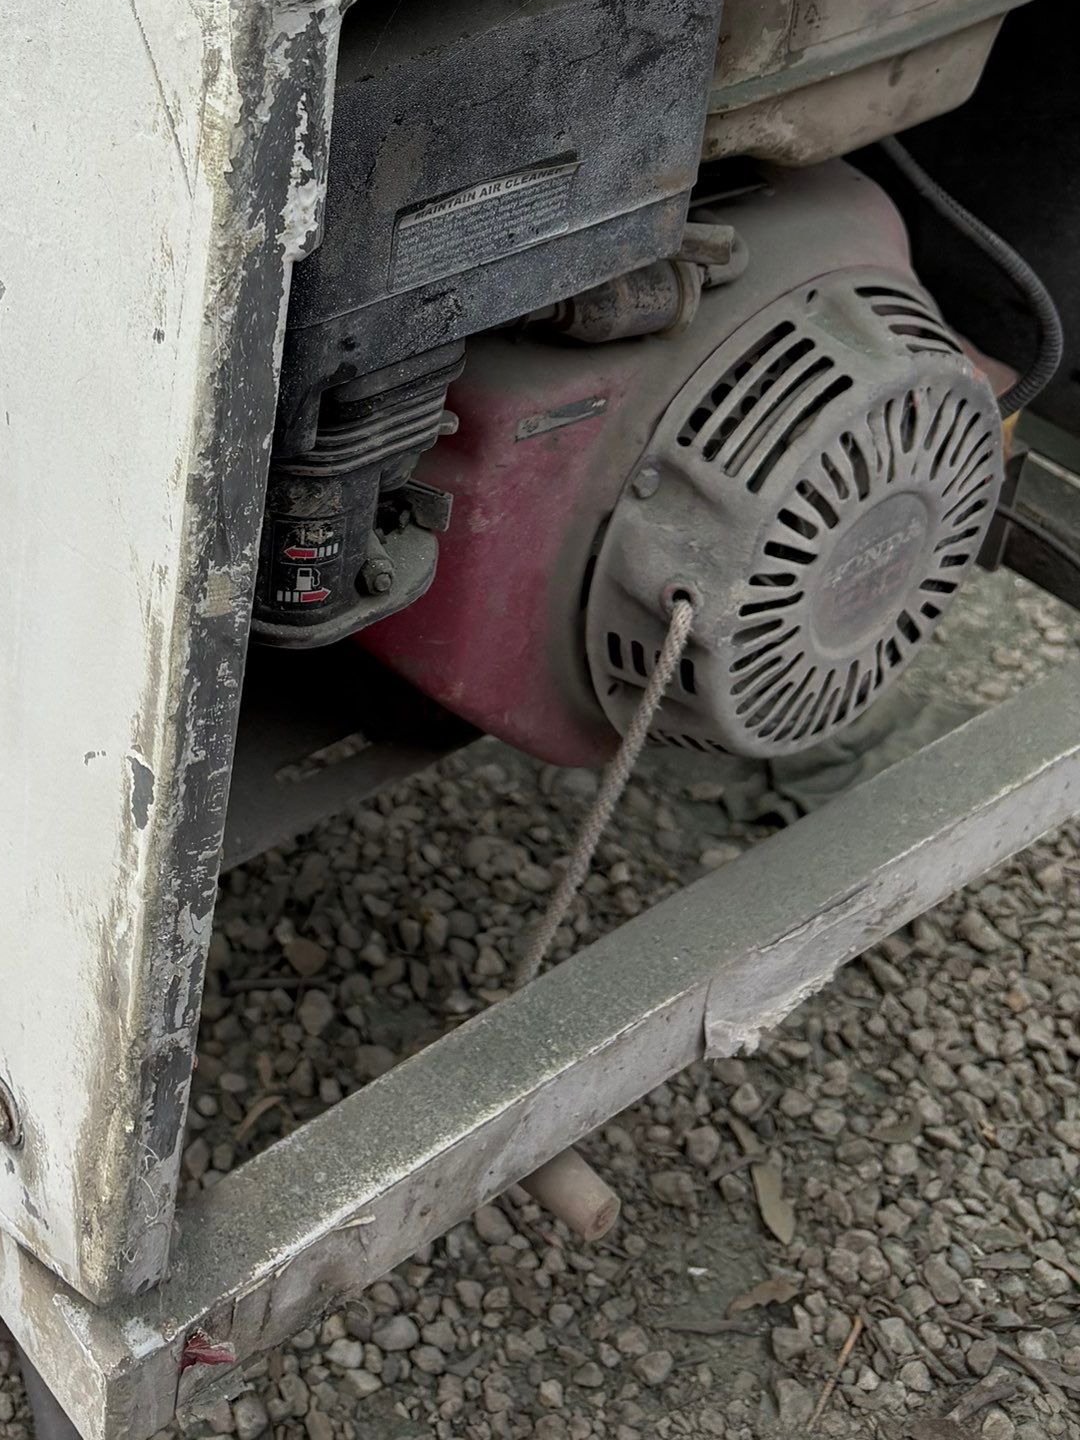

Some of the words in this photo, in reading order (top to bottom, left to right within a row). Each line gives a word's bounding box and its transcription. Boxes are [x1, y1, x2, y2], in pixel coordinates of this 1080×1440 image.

[415, 190, 476, 220] MAINTAIN
[479, 182, 502, 198] AIR
[505, 166, 564, 189] CLEANER
